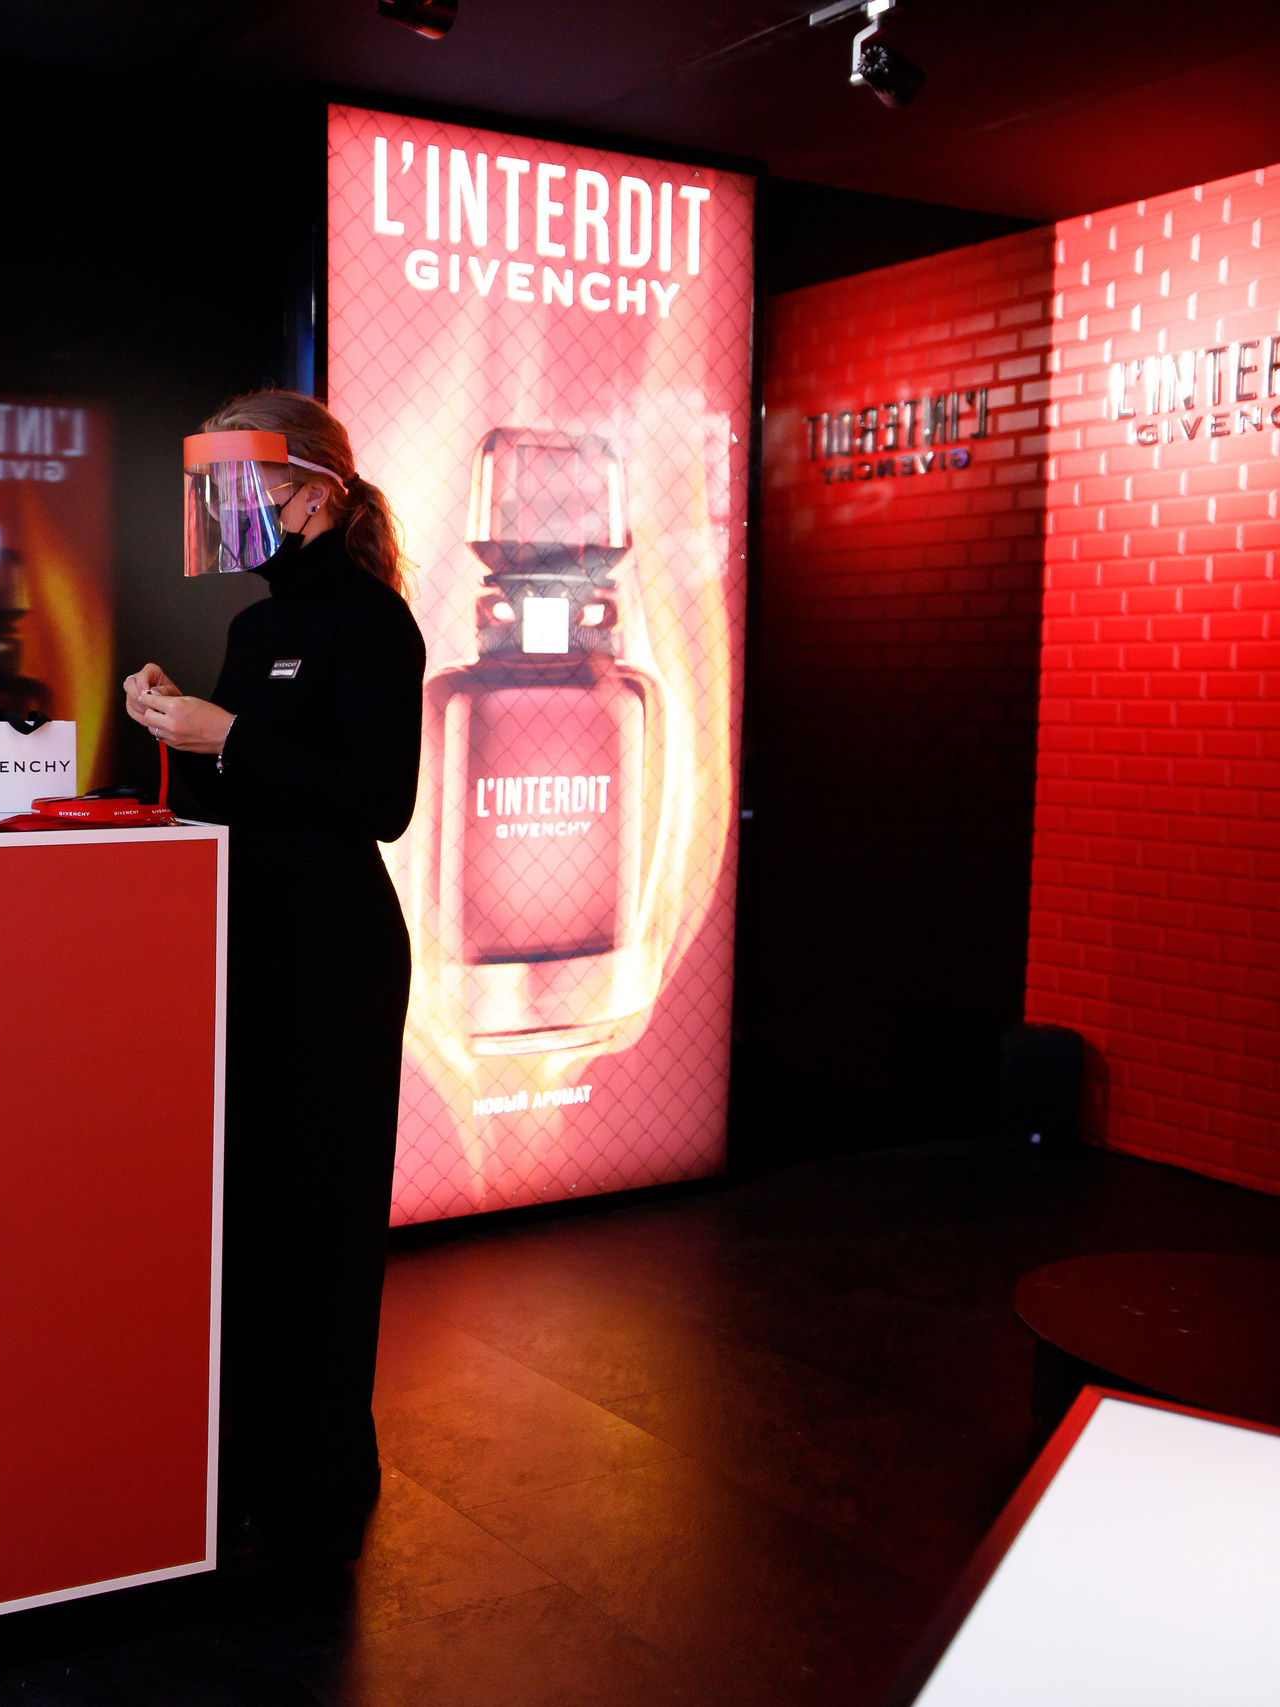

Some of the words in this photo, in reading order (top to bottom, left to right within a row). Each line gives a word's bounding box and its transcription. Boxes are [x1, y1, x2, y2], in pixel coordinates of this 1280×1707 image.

[374, 136, 710, 275] L'INTERDIT
[405, 249, 680, 318] GIVENCHY
[477, 775, 611, 817] L'INTERDIT
[496, 821, 591, 839] GIVENCHY
[473, 1090, 528, 1116] НОВЫЙ
[532, 1085, 593, 1110] АРОМАТ
